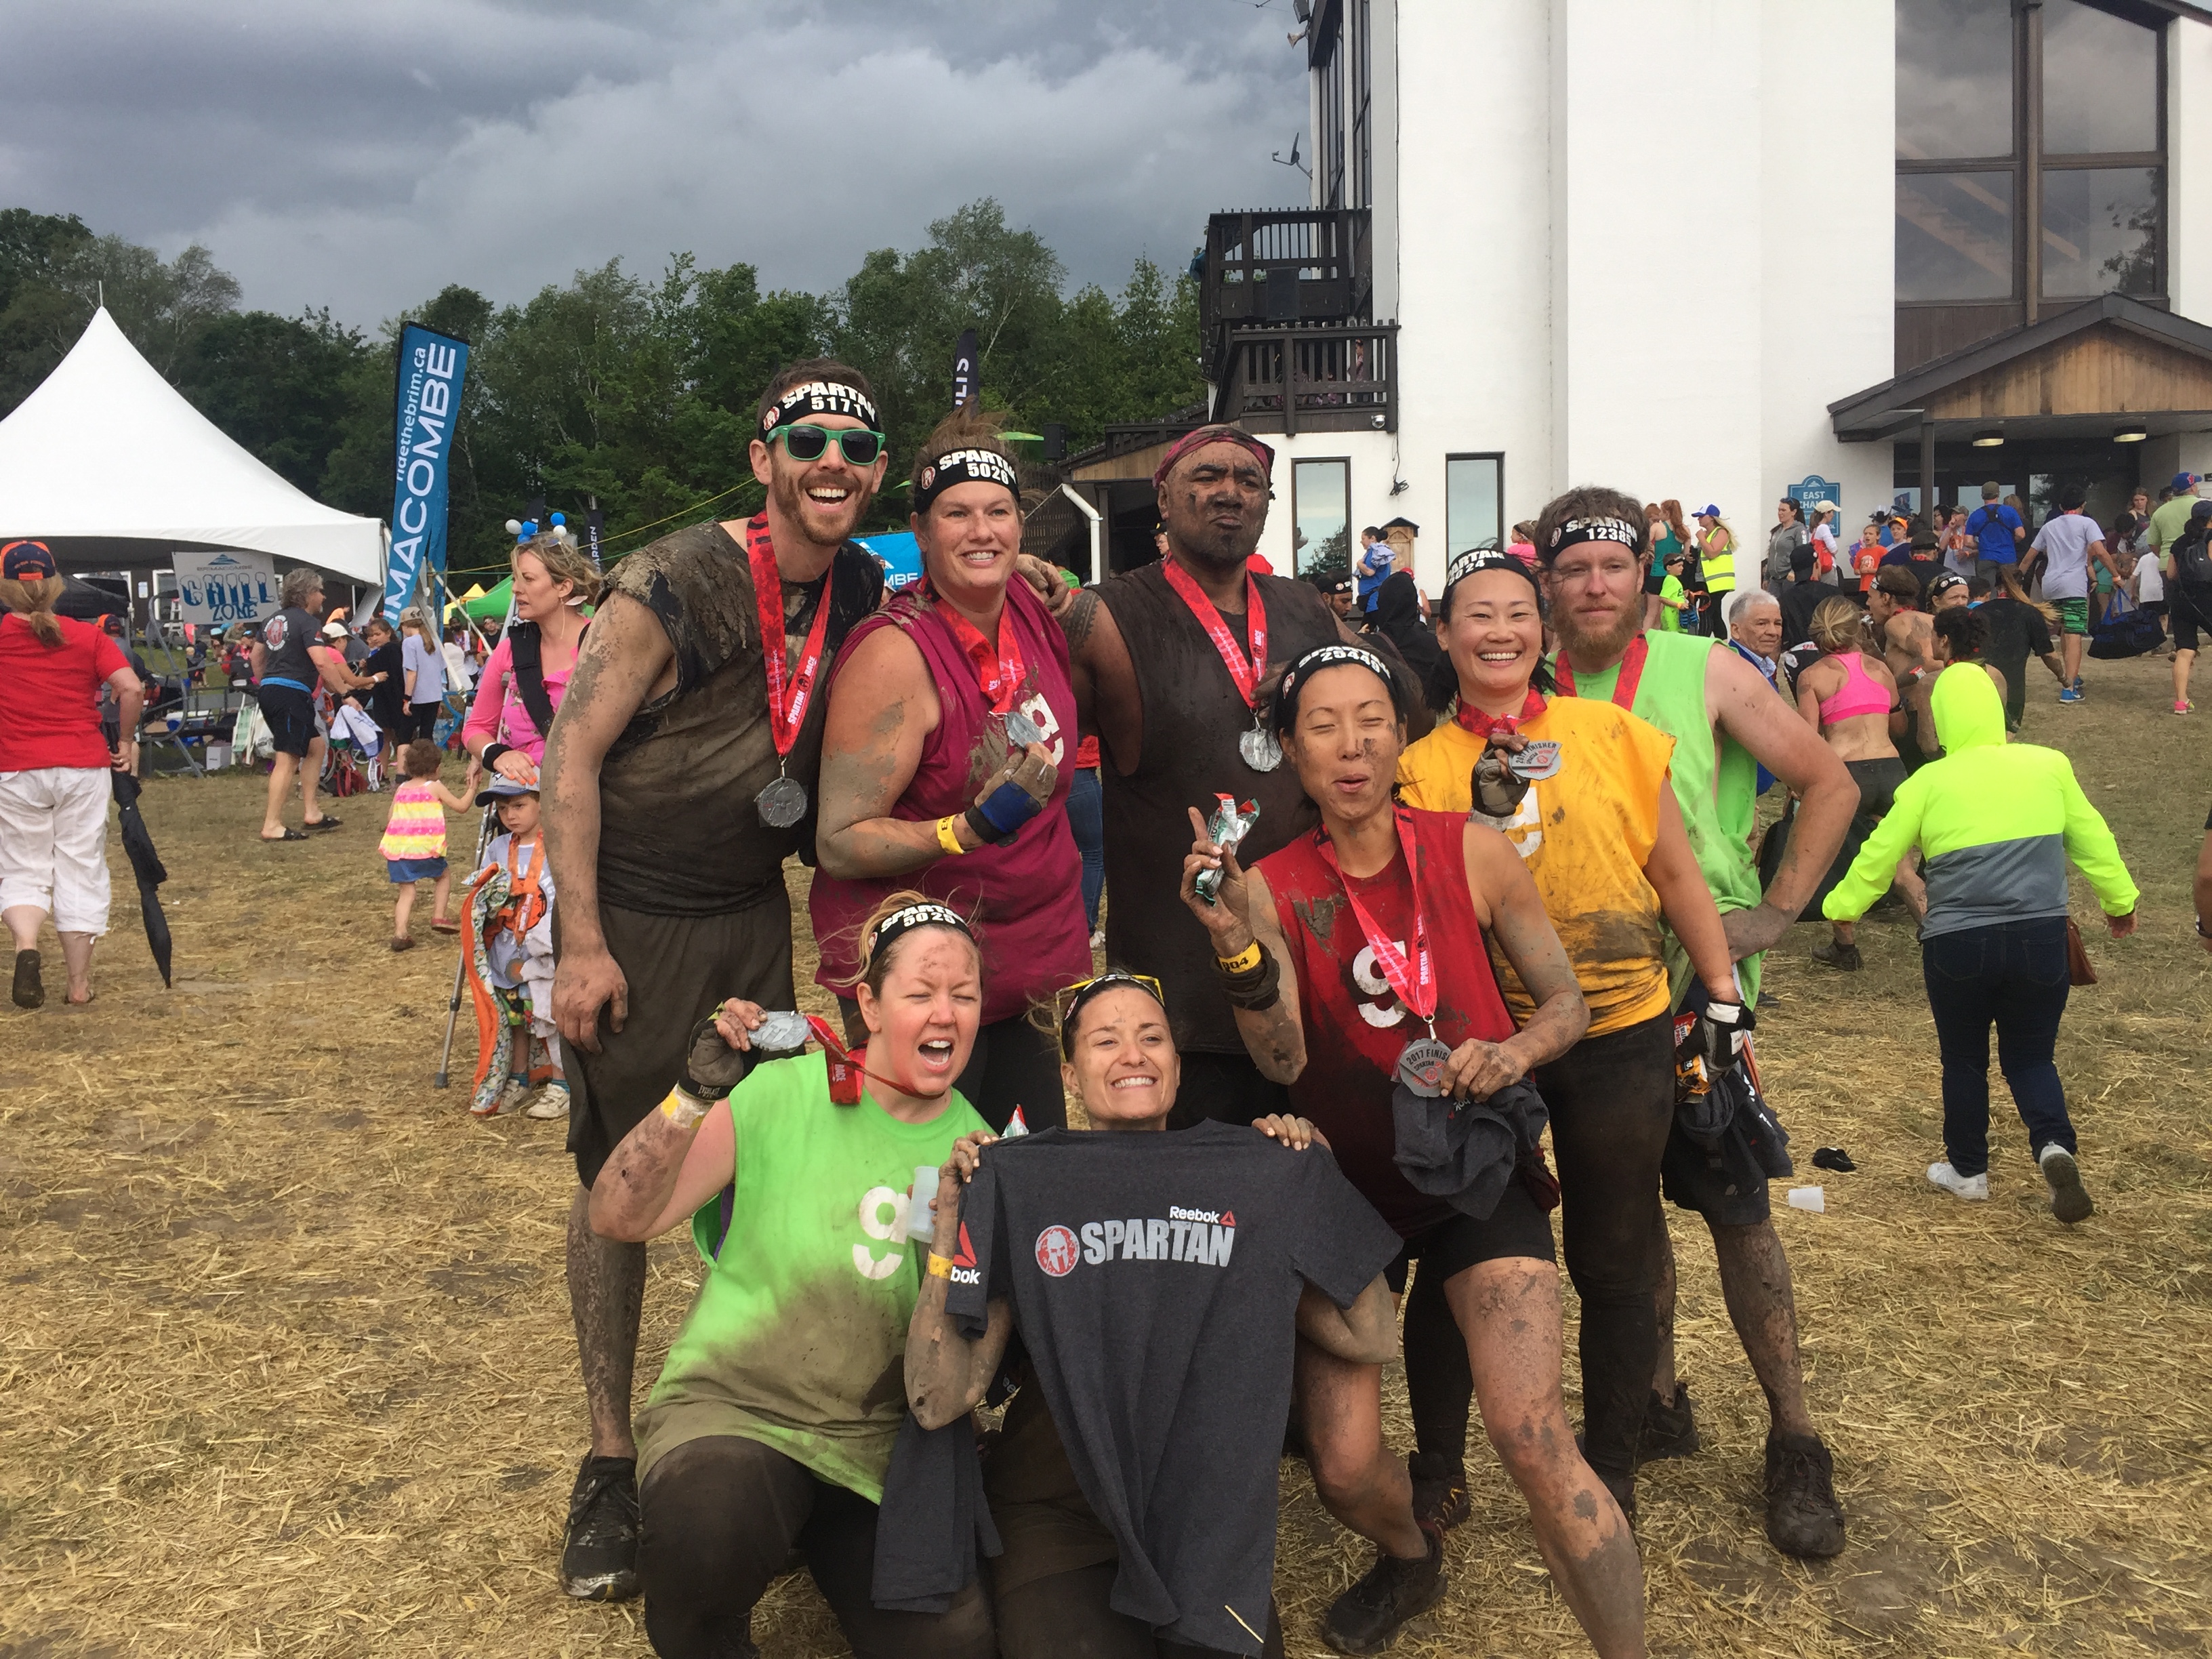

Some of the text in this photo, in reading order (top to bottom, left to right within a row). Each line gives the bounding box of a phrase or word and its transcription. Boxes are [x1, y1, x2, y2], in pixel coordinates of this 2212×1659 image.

[782, 382, 876, 423] SPARTAN
[383, 342, 456, 621] IMACOMBE
[967, 463, 1009, 485] 5026
[1799, 501, 1819, 509] CHA
[1803, 491, 1826, 499] EAST
[1565, 516, 1637, 542] SPARTAN
[1586, 527, 1632, 547] 12385
[1446, 550, 1505, 583] PARTAN
[180, 571, 275, 608] CHILL
[212, 601, 258, 621] ZONE
[787, 689, 805, 725] SPARTAN
[1406, 1050, 1424, 1065] 2017
[1414, 1061, 1435, 1071] SPARTAN
[1169, 1206, 1220, 1224] Reebok
[852, 1186, 911, 1280] 9
[1080, 1218, 1235, 1267] SPARTAN
